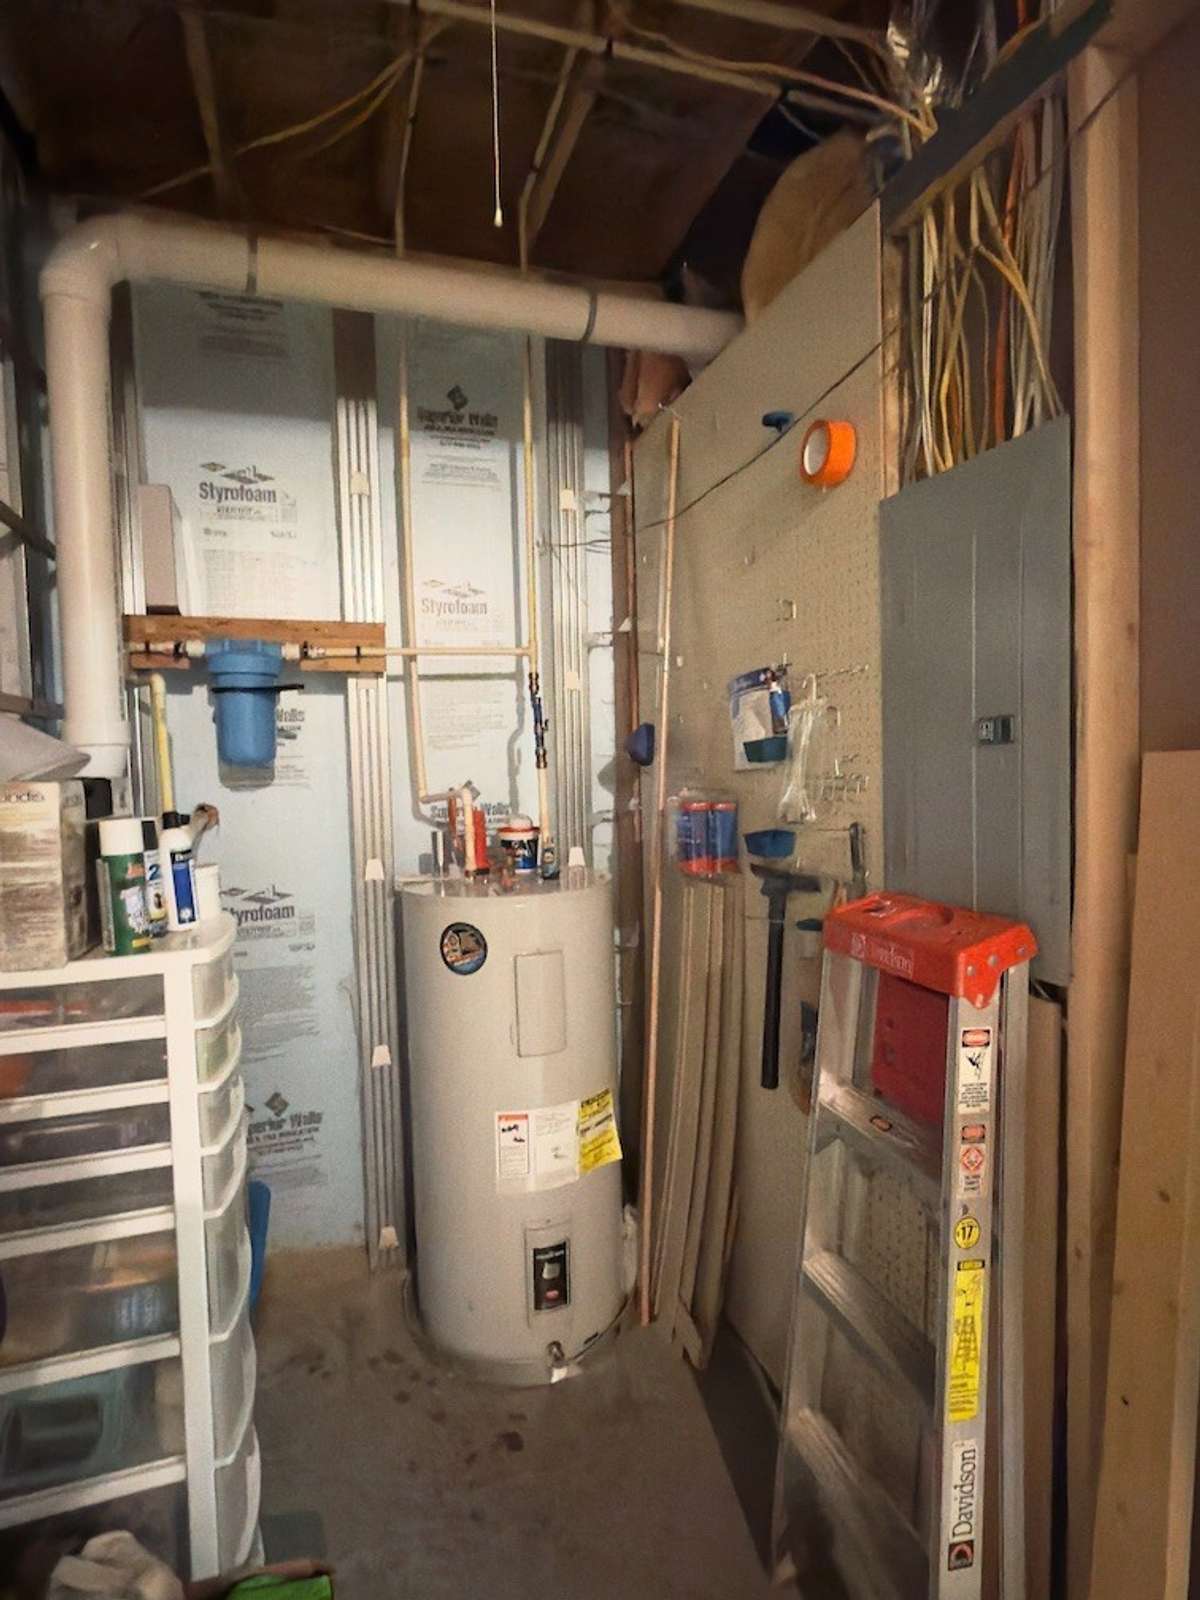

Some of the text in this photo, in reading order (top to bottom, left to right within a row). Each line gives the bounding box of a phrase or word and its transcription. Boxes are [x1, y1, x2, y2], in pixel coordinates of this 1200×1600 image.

[199, 481, 277, 502] Styrofoam
[421, 598, 488, 617] Styrofoam
[148, 864, 160, 880] 2
[221, 905, 295, 926] tyrofoam
[960, 1225, 974, 1241] 17
[952, 1448, 977, 1538] Davidson
